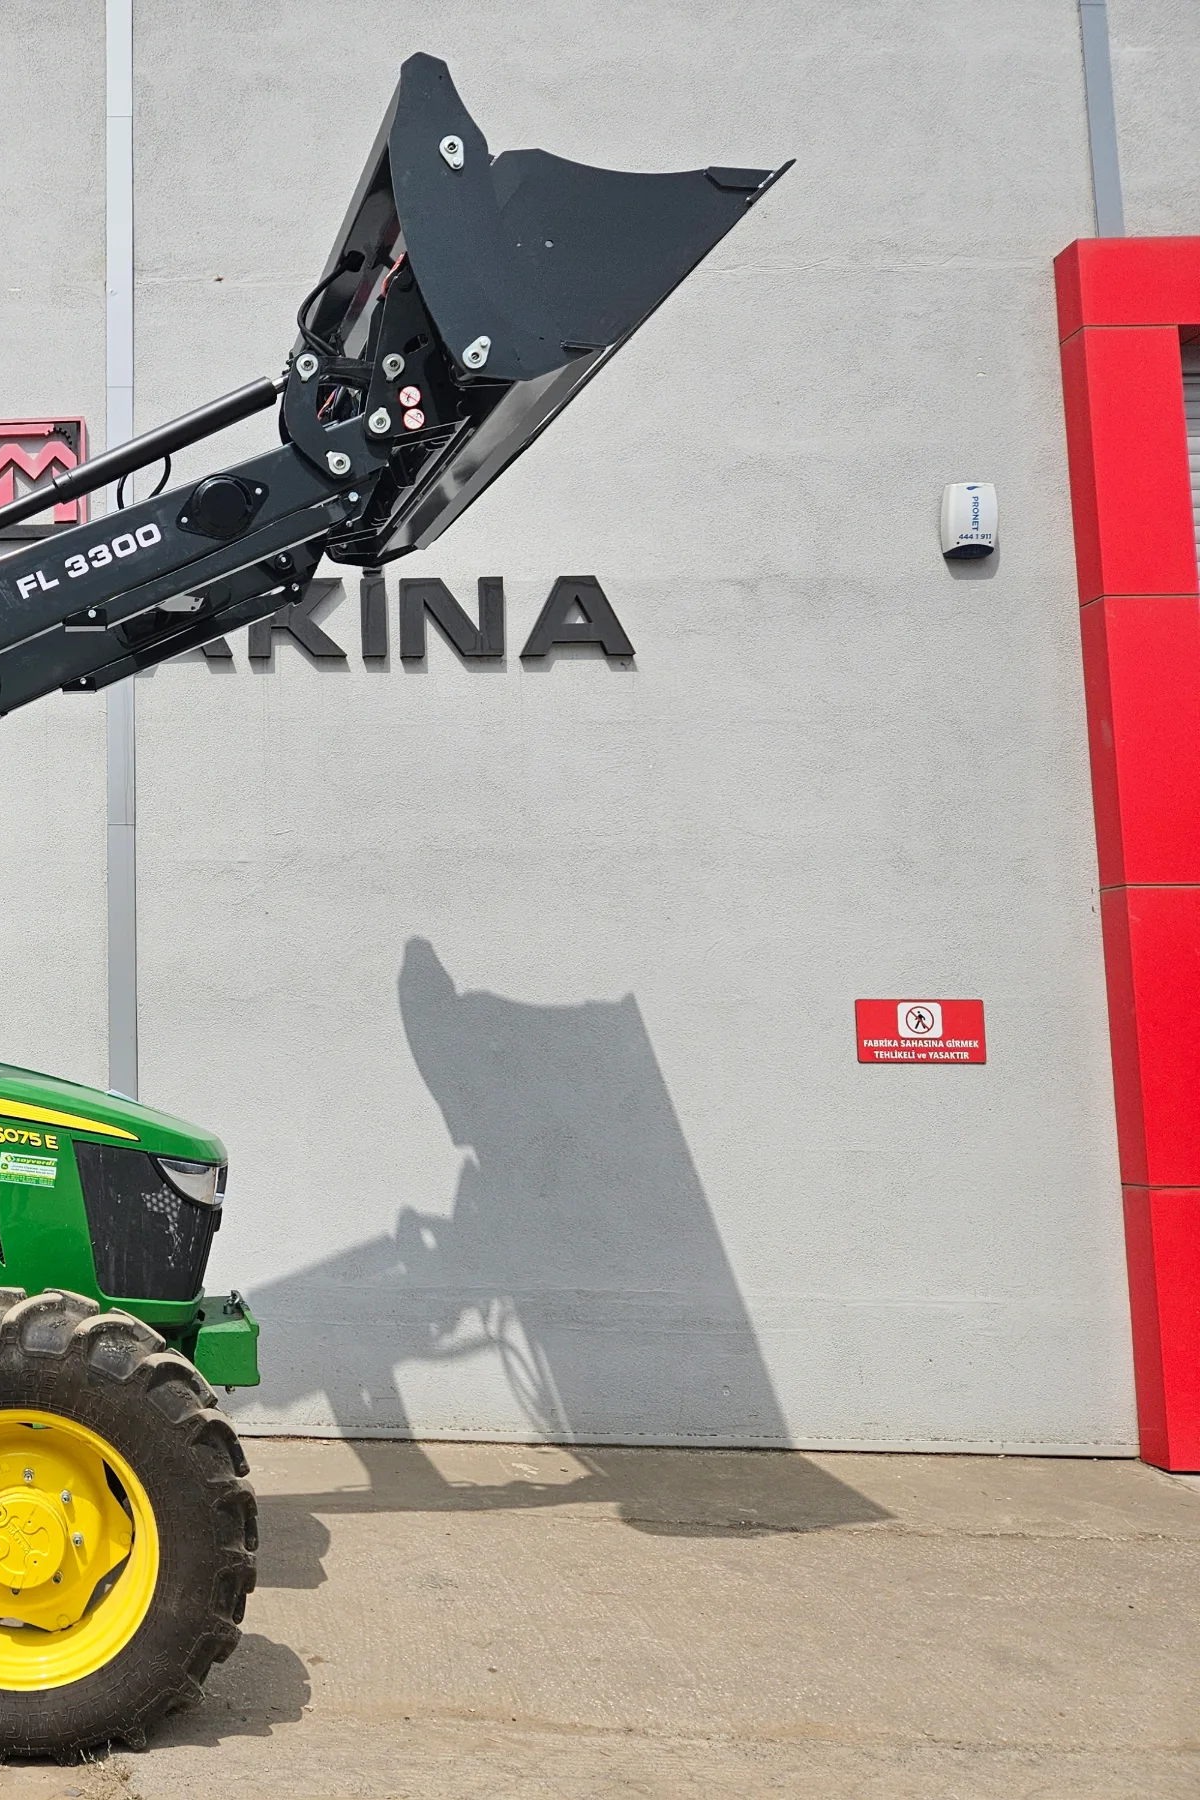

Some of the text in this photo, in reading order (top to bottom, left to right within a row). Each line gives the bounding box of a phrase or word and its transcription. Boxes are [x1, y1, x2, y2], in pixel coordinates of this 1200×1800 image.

[972, 496, 980, 531] PRONET
[16, 522, 162, 600] FL 3300
[863, 1038, 979, 1048] FABRİKA SAHASINA GİRMEK
[873, 1050, 915, 1059] TEHLİKELİ
[928, 1051, 970, 1060] YASAKTIR
[44, 1134, 59, 1151] E
